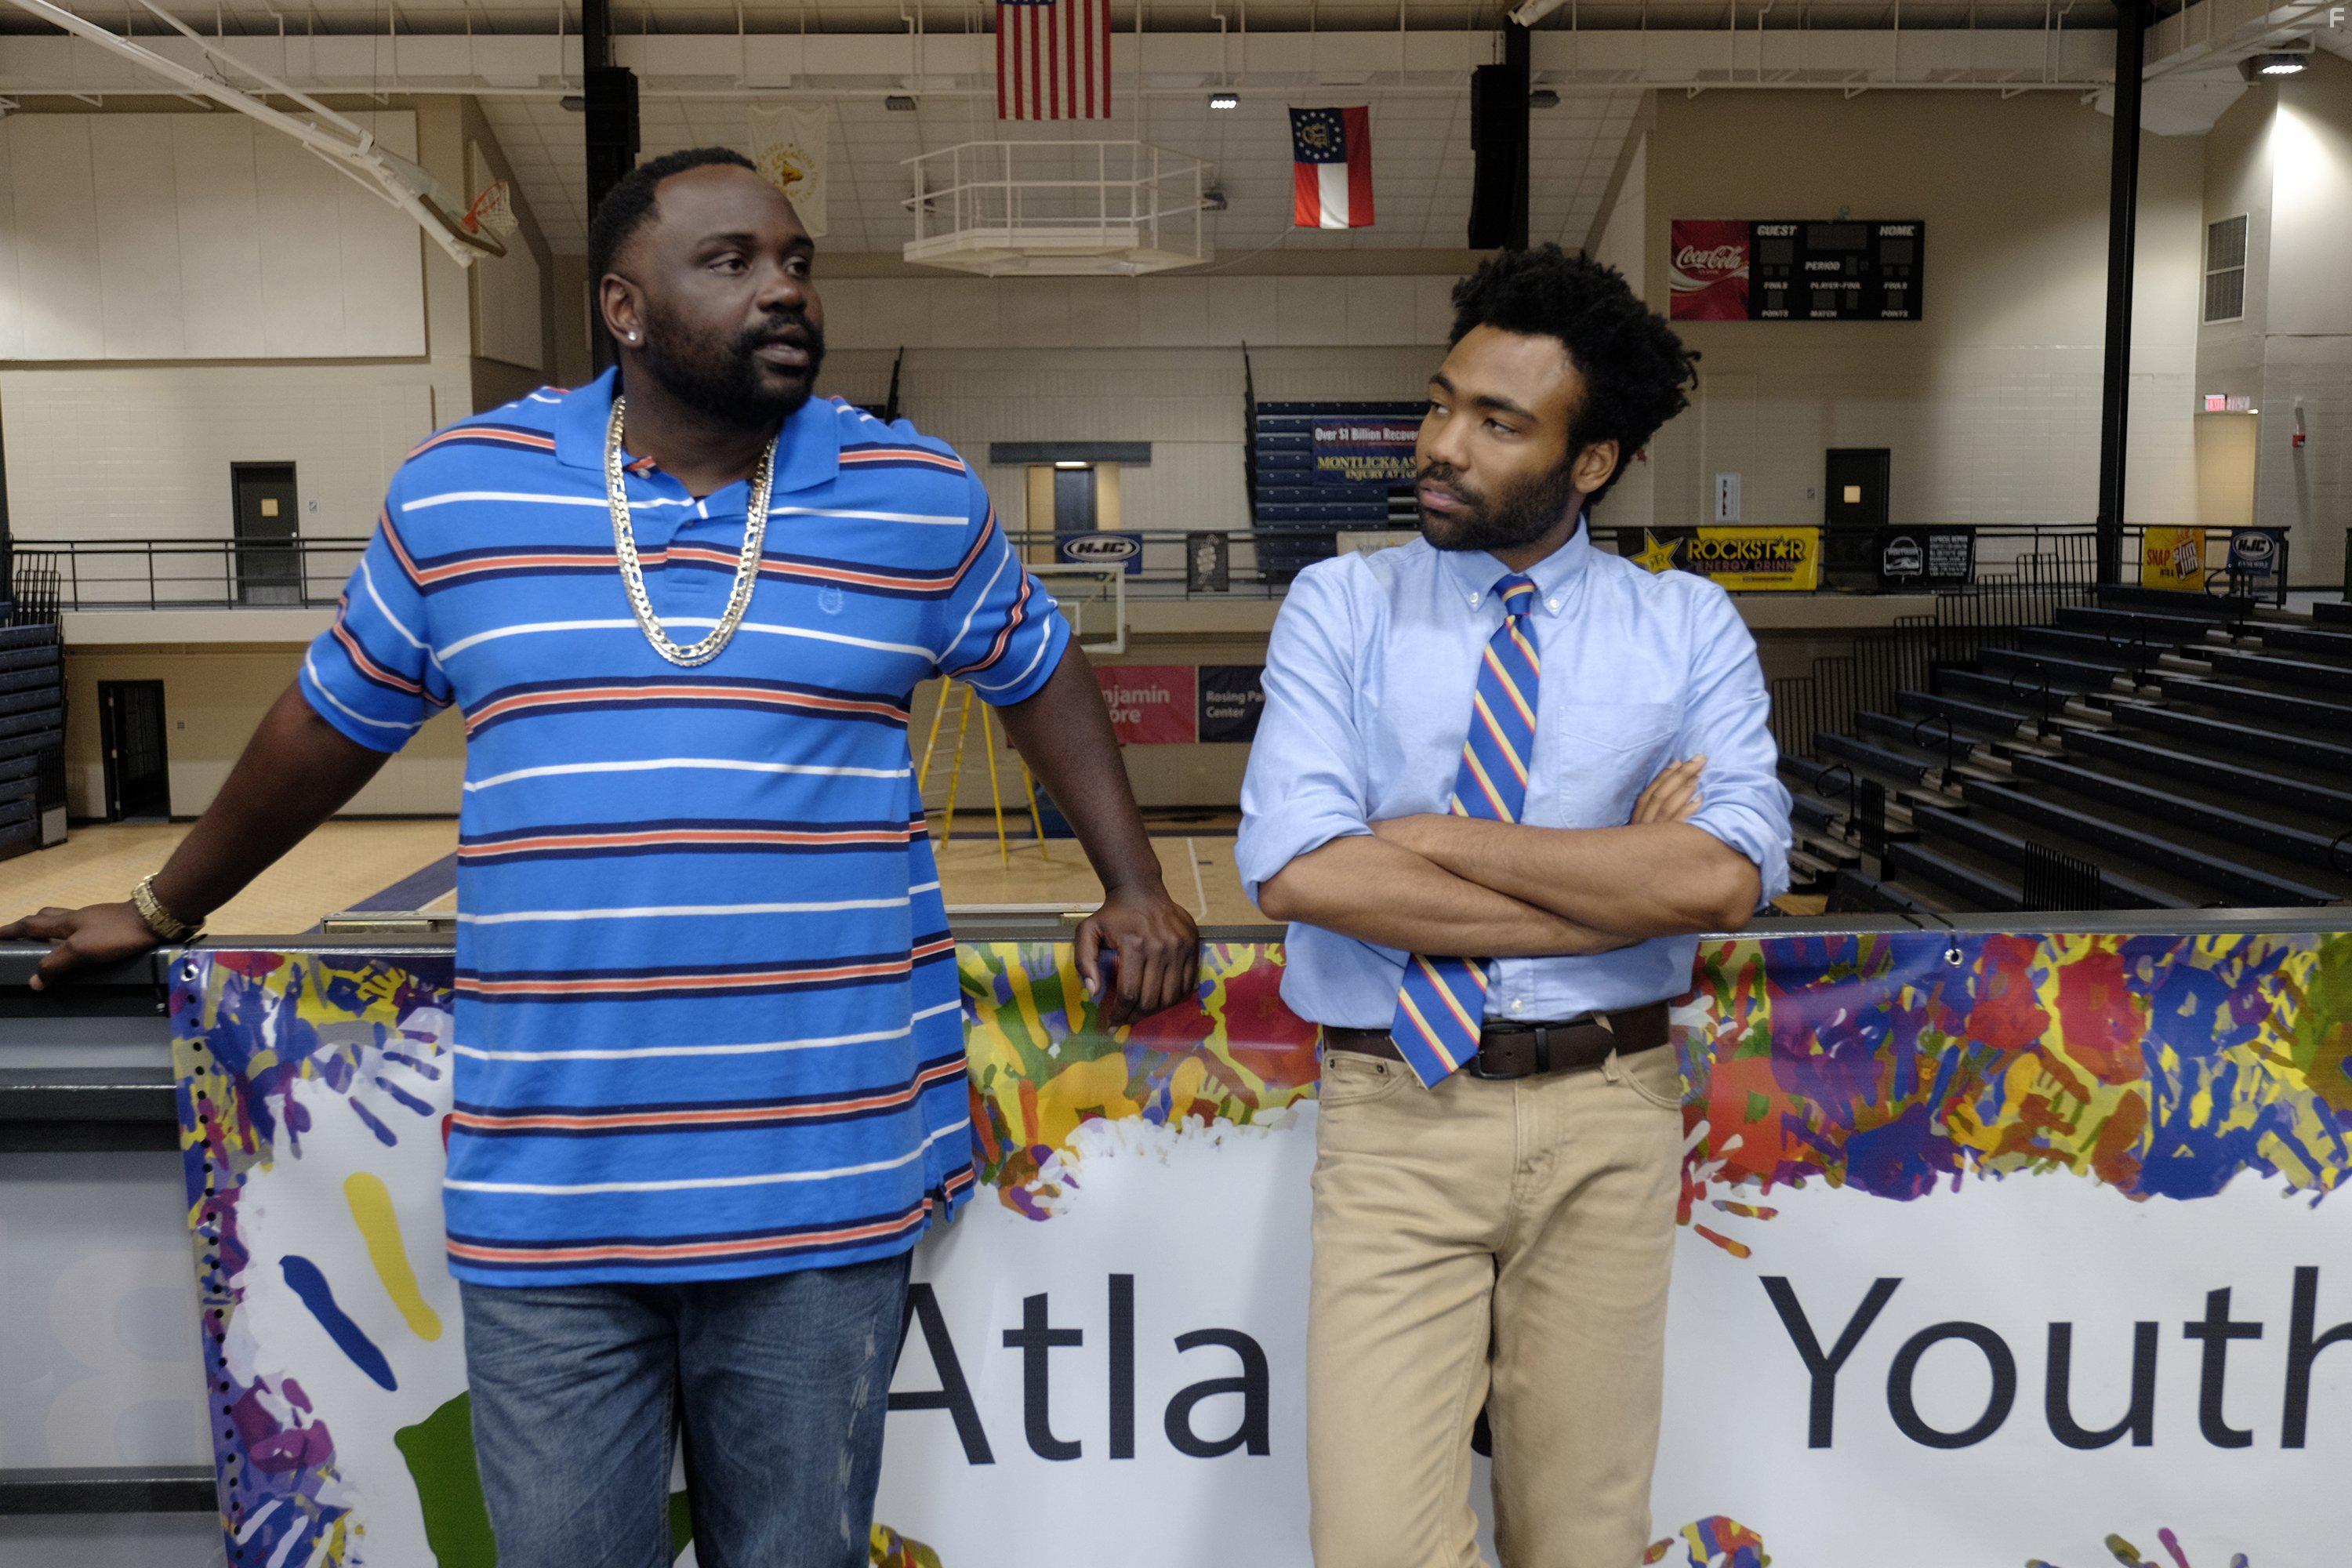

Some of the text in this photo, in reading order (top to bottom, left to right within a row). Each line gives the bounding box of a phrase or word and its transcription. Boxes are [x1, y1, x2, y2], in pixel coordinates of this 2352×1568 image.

[1757, 224, 1797, 237] GUEST
[1879, 225, 1915, 237] HOME
[1805, 261, 1840, 271] PERIOD
[1762, 310, 1789, 318] POINTS
[1881, 310, 1908, 318] POINTS
[1315, 427, 1338, 441] Over
[1338, 427, 1348, 441] $1
[1351, 427, 1381, 441] Billion
[1317, 456, 1388, 470] MONTLICK
[1076, 542, 1126, 554] HJC
[2238, 539, 2267, 552] HJC
[2147, 549, 2170, 566] SNAP
[1695, 560, 1795, 573] ENERGY DRINK
[1206, 706, 1245, 718] Center
[887, 1265, 2352, 1466] Atla Youth
